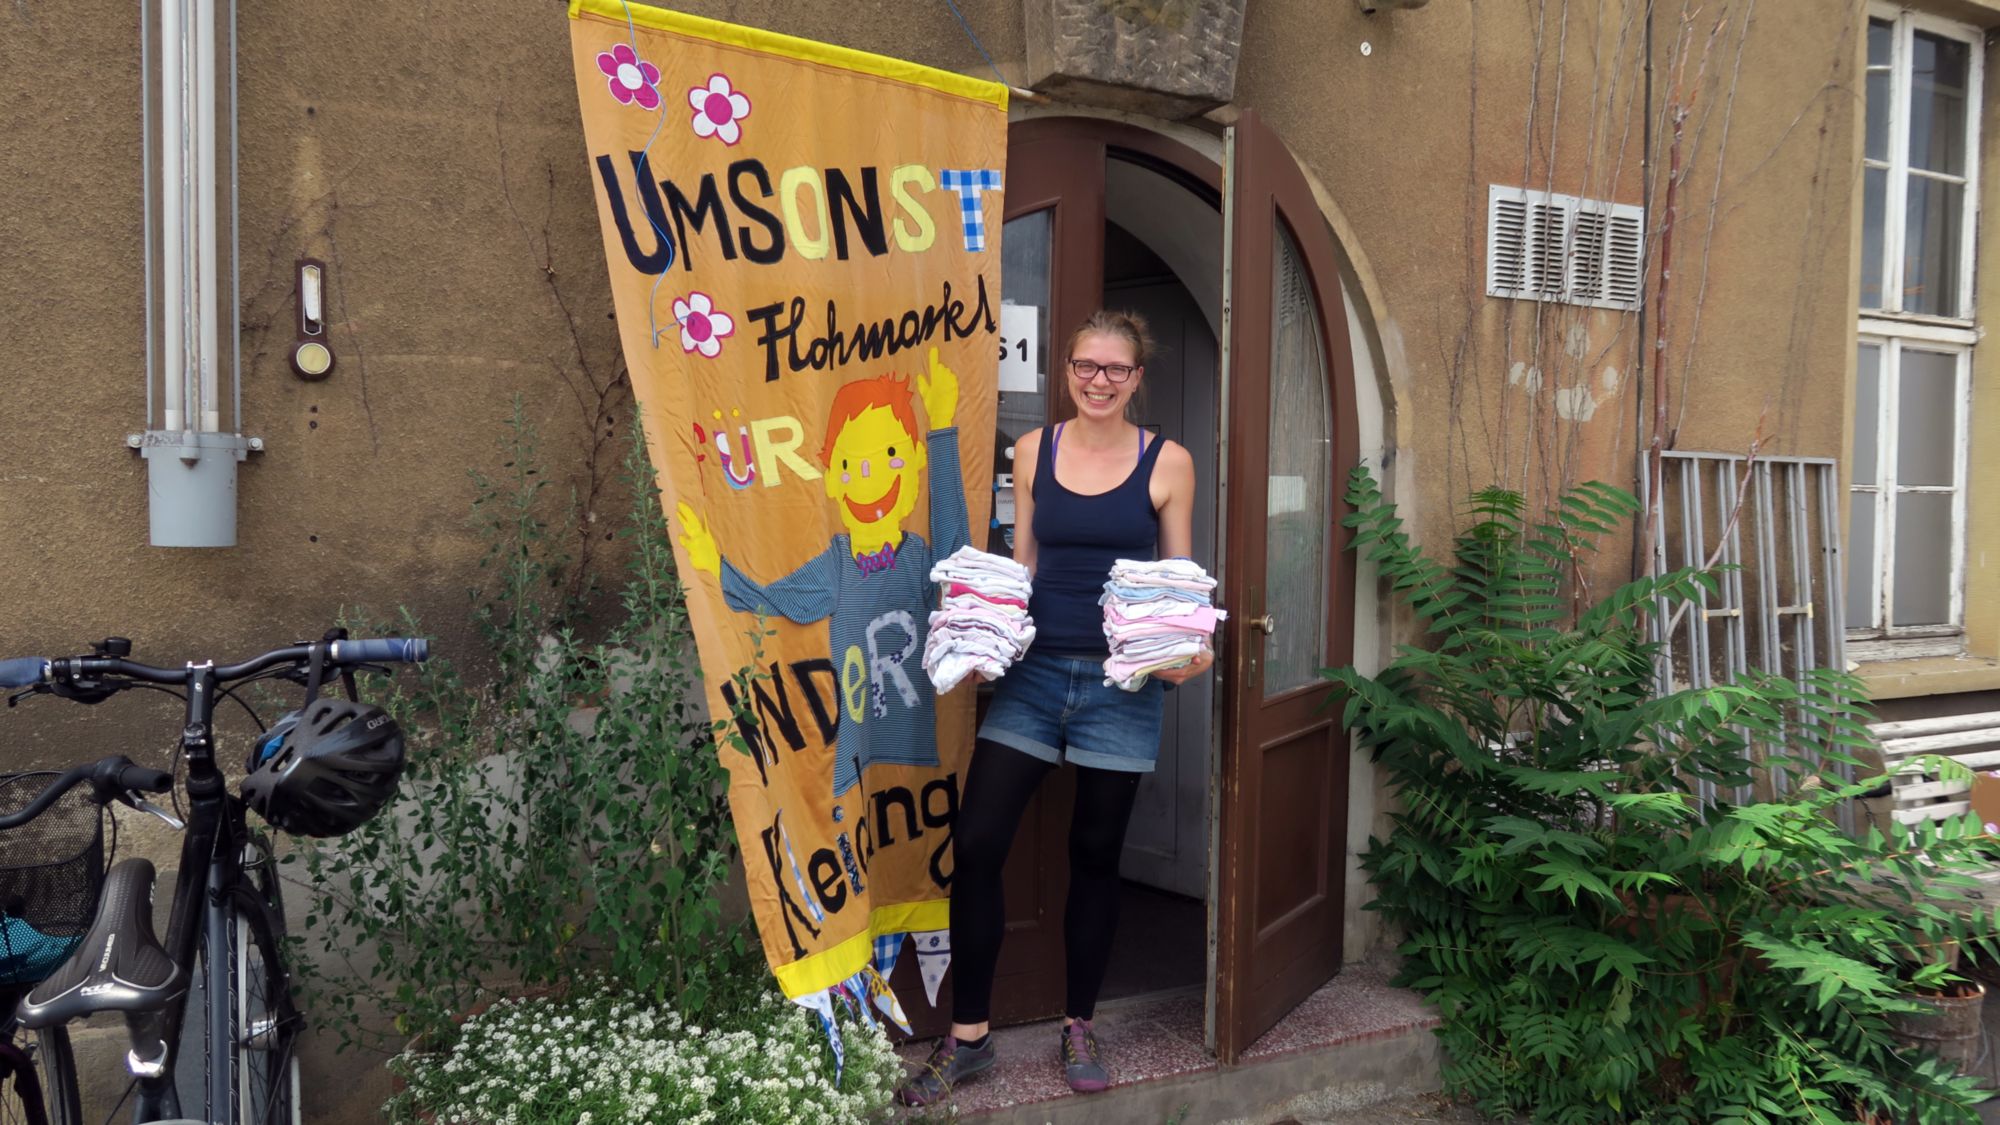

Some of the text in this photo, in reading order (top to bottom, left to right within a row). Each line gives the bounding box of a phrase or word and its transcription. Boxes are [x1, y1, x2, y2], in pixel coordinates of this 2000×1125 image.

[596, 151, 1001, 275] UMSONST
[1016, 338, 1028, 362] 1
[761, 753, 959, 961] Kleidng
